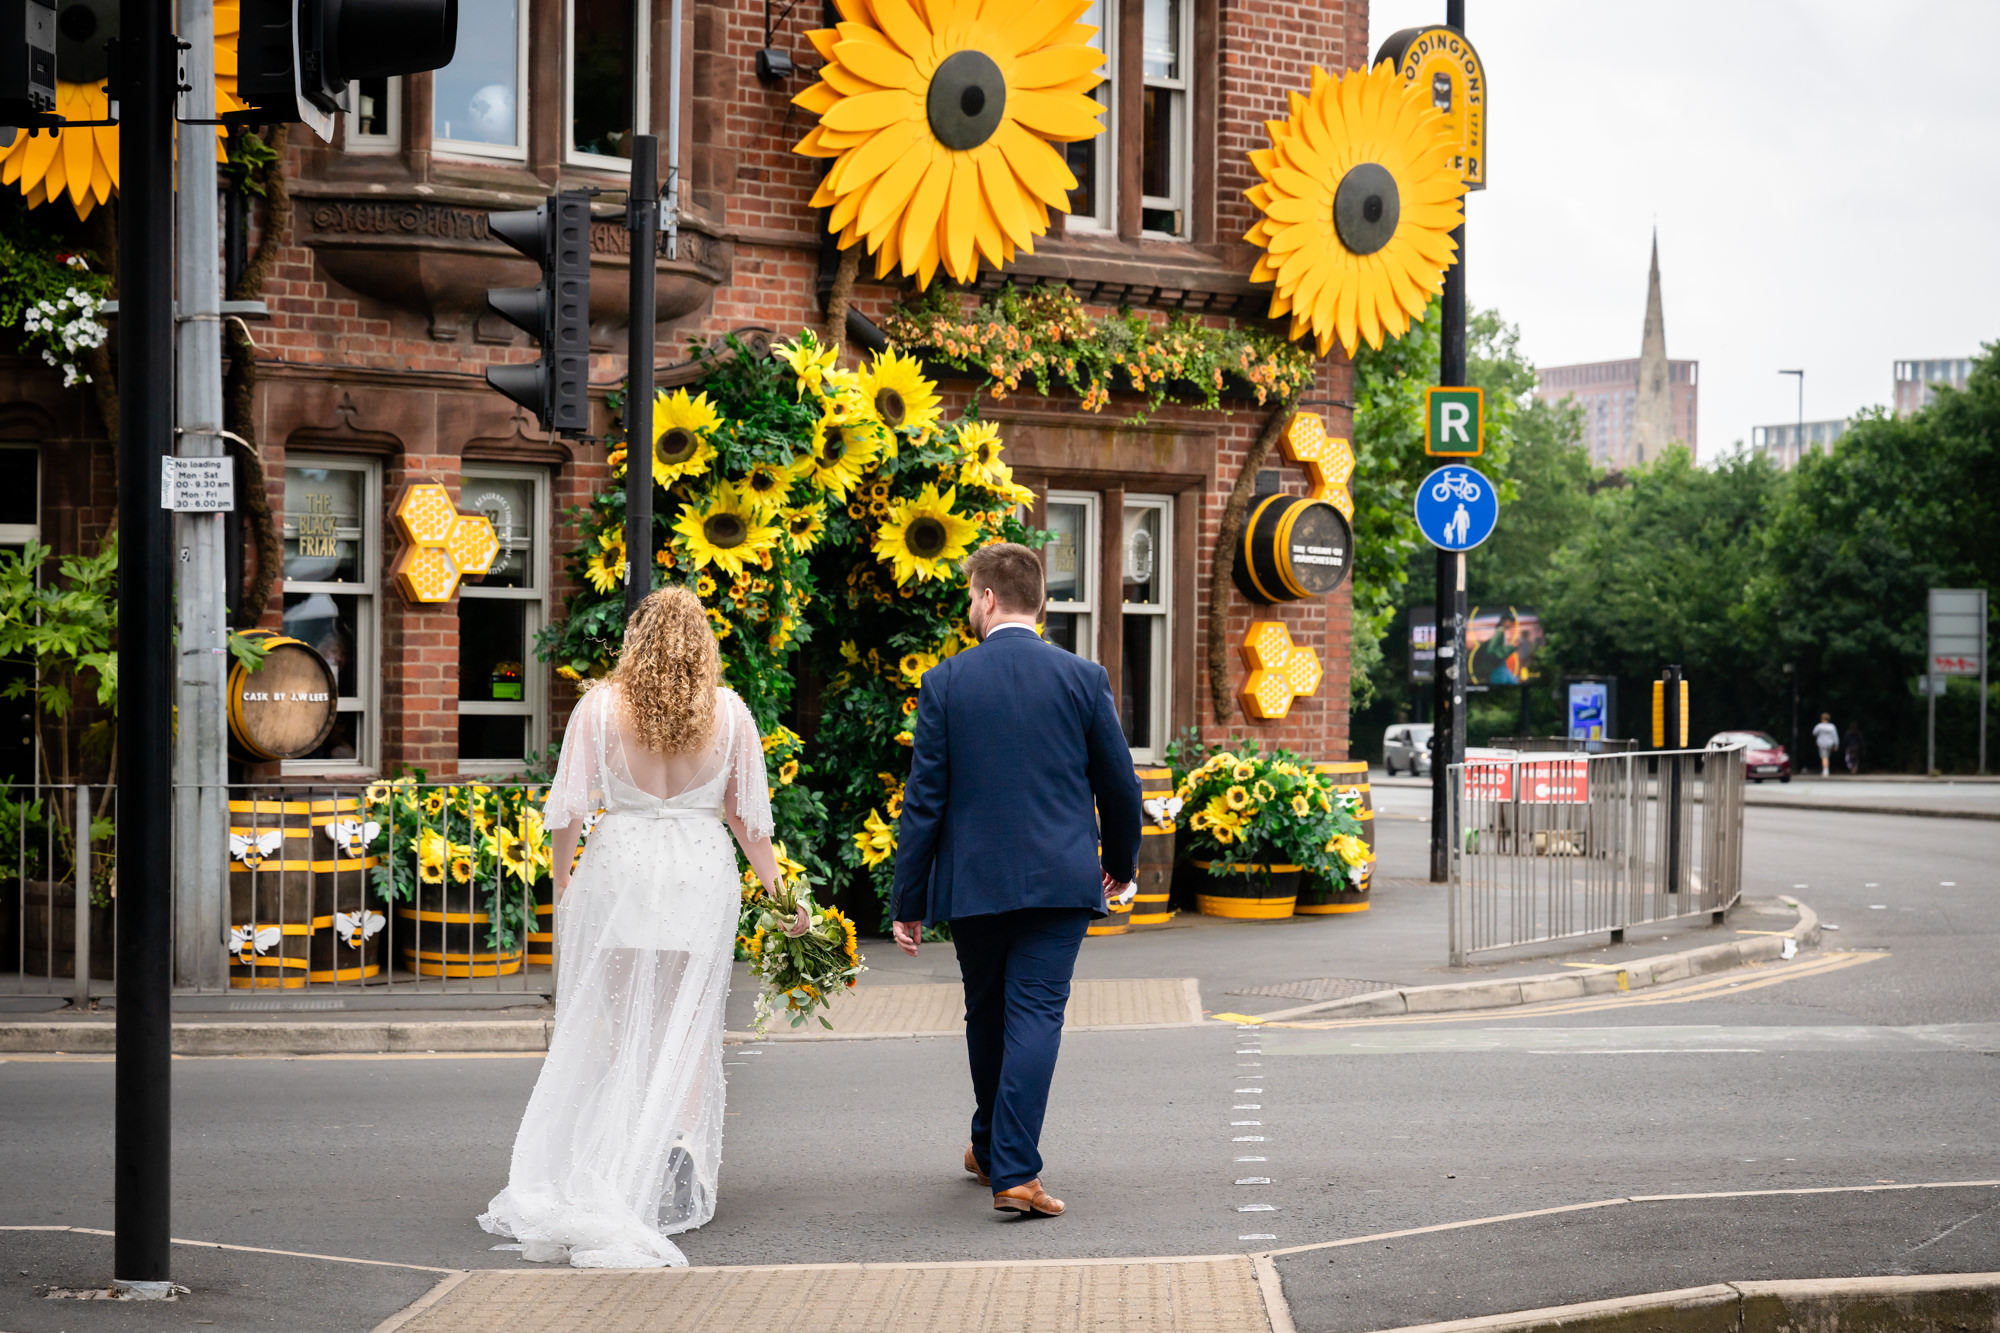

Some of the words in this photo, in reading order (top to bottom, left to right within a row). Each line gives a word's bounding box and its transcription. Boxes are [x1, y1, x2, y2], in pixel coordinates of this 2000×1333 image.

[1404, 34, 1480, 105] ODDINGTONS
[1441, 402, 1470, 443] R
[175, 461, 188, 469] No
[190, 461, 221, 469] loading
[178, 471, 197, 479] Mon
[203, 471, 218, 479] Sat
[195, 500, 216, 508] 6.00
[305, 493, 332, 514] THE
[298, 515, 338, 536] BLACK
[298, 536, 337, 557] FRIAR
[1293, 554, 1343, 566] MANCHESTER
[242, 691, 268, 702] CASK
[273, 692, 286, 702] BY
[1465, 773, 1506, 785] LOSED
